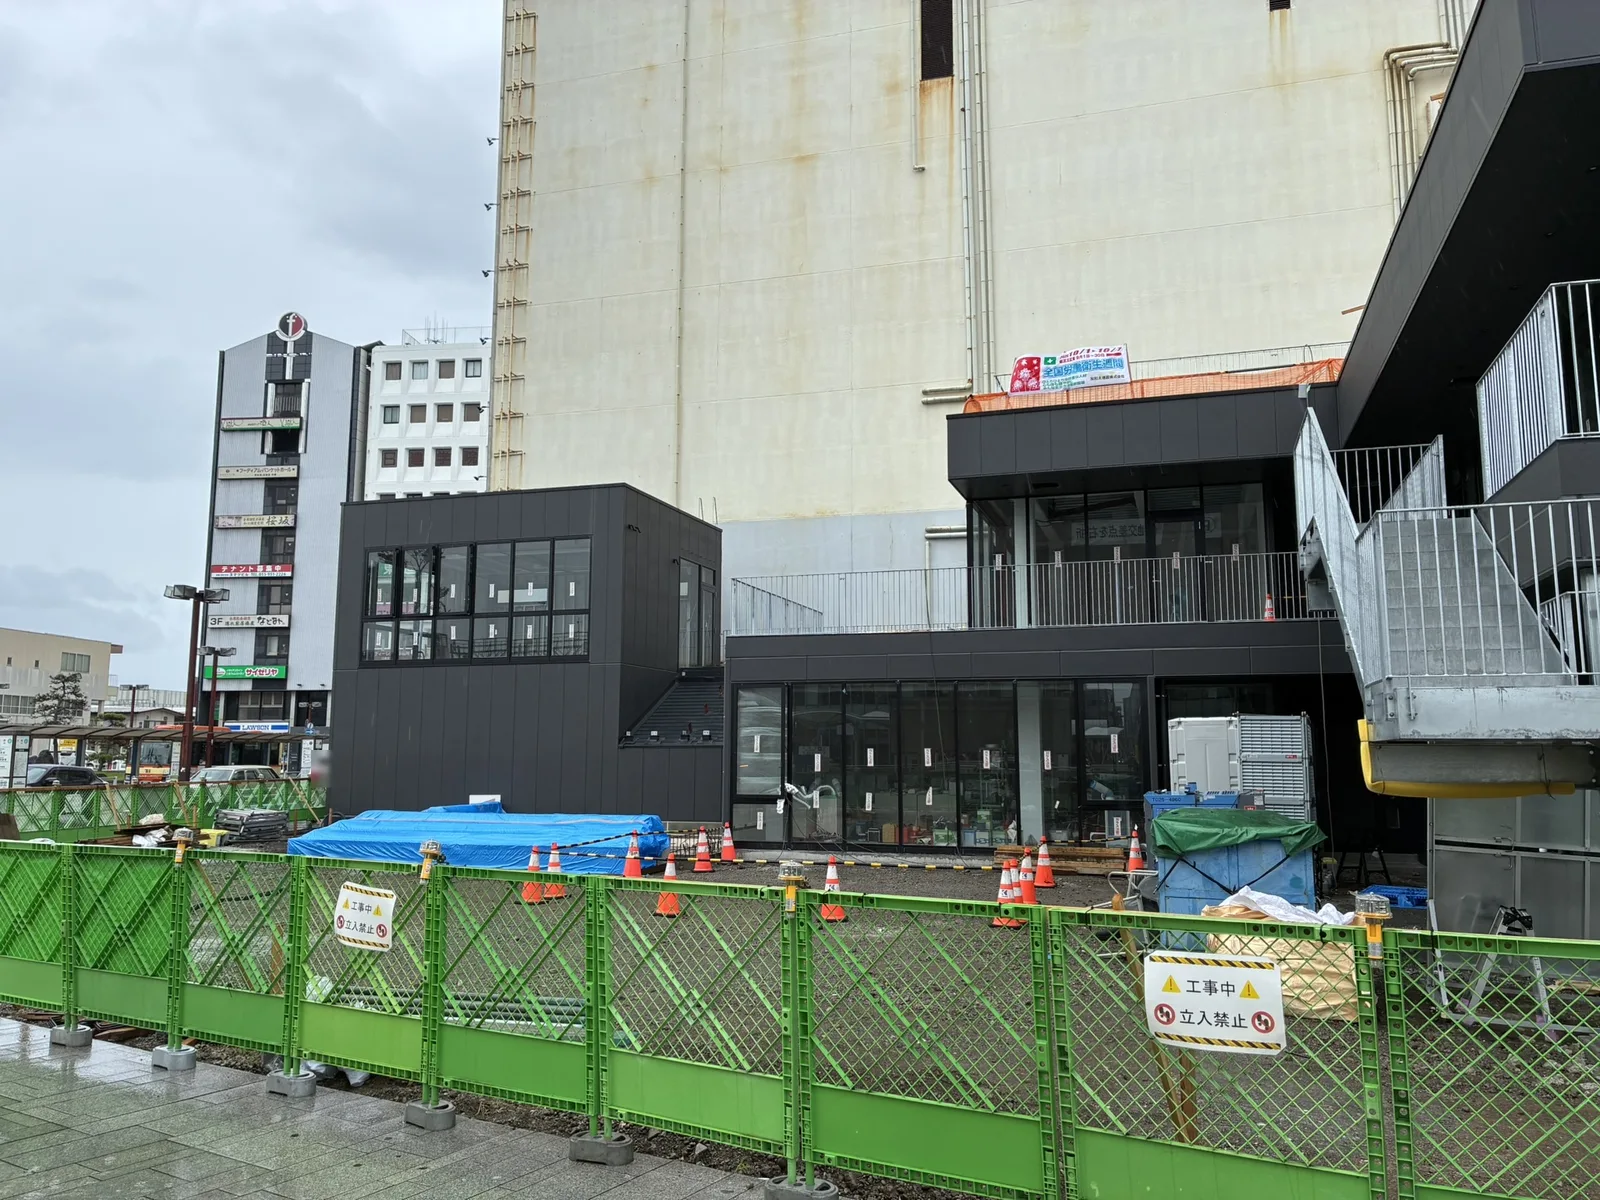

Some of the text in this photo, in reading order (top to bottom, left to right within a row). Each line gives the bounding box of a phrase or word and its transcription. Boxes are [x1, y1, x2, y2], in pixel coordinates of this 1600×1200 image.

[1042, 358, 1124, 378] 全国労働衛生週間
[210, 617, 223, 626] 3F
[245, 668, 278, 676] サイゼリヤ
[351, 901, 372, 914] 工事中
[345, 920, 375, 934] 立入禁止
[1186, 979, 1236, 997] 工事中
[1179, 1008, 1248, 1029] 立入禁止
